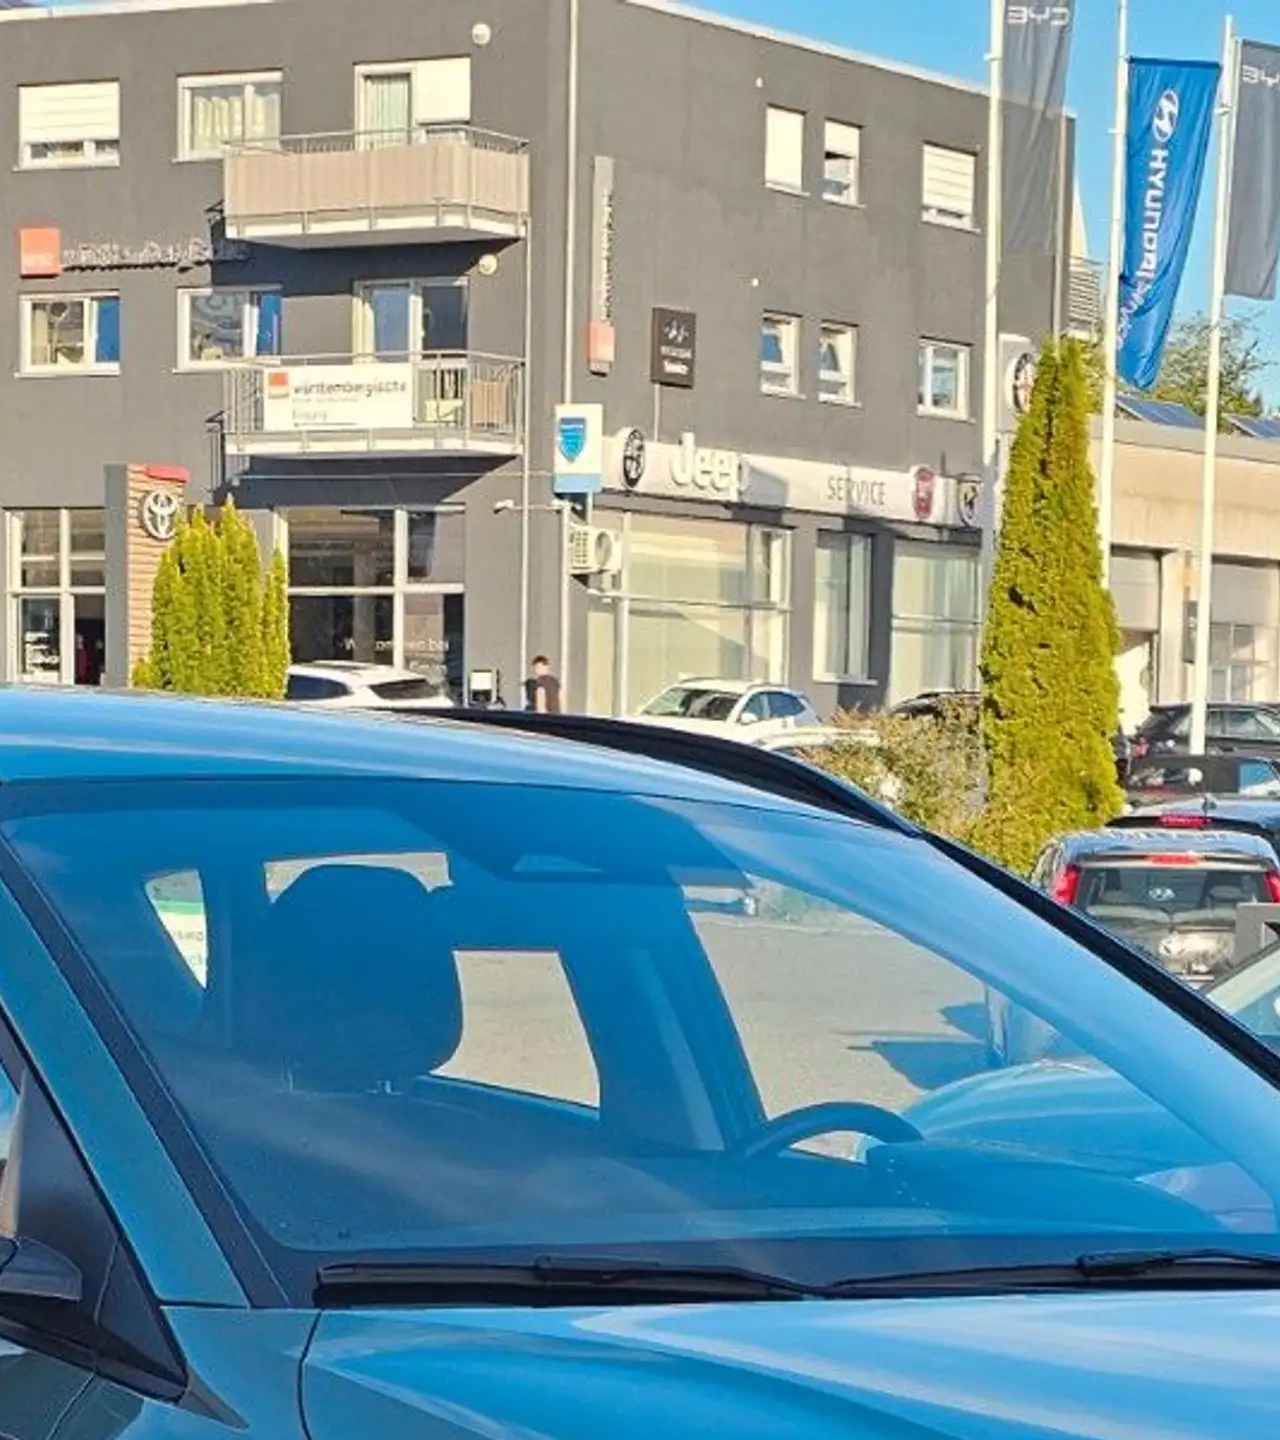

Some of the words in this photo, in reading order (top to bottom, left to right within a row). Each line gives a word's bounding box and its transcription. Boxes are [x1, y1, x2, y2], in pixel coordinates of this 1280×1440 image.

[1008, 5, 1070, 26] BYD
[1135, 150, 1169, 279] HYUNDAI
[670, 431, 751, 503] Jeep
[827, 475, 886, 506] SERVICE
